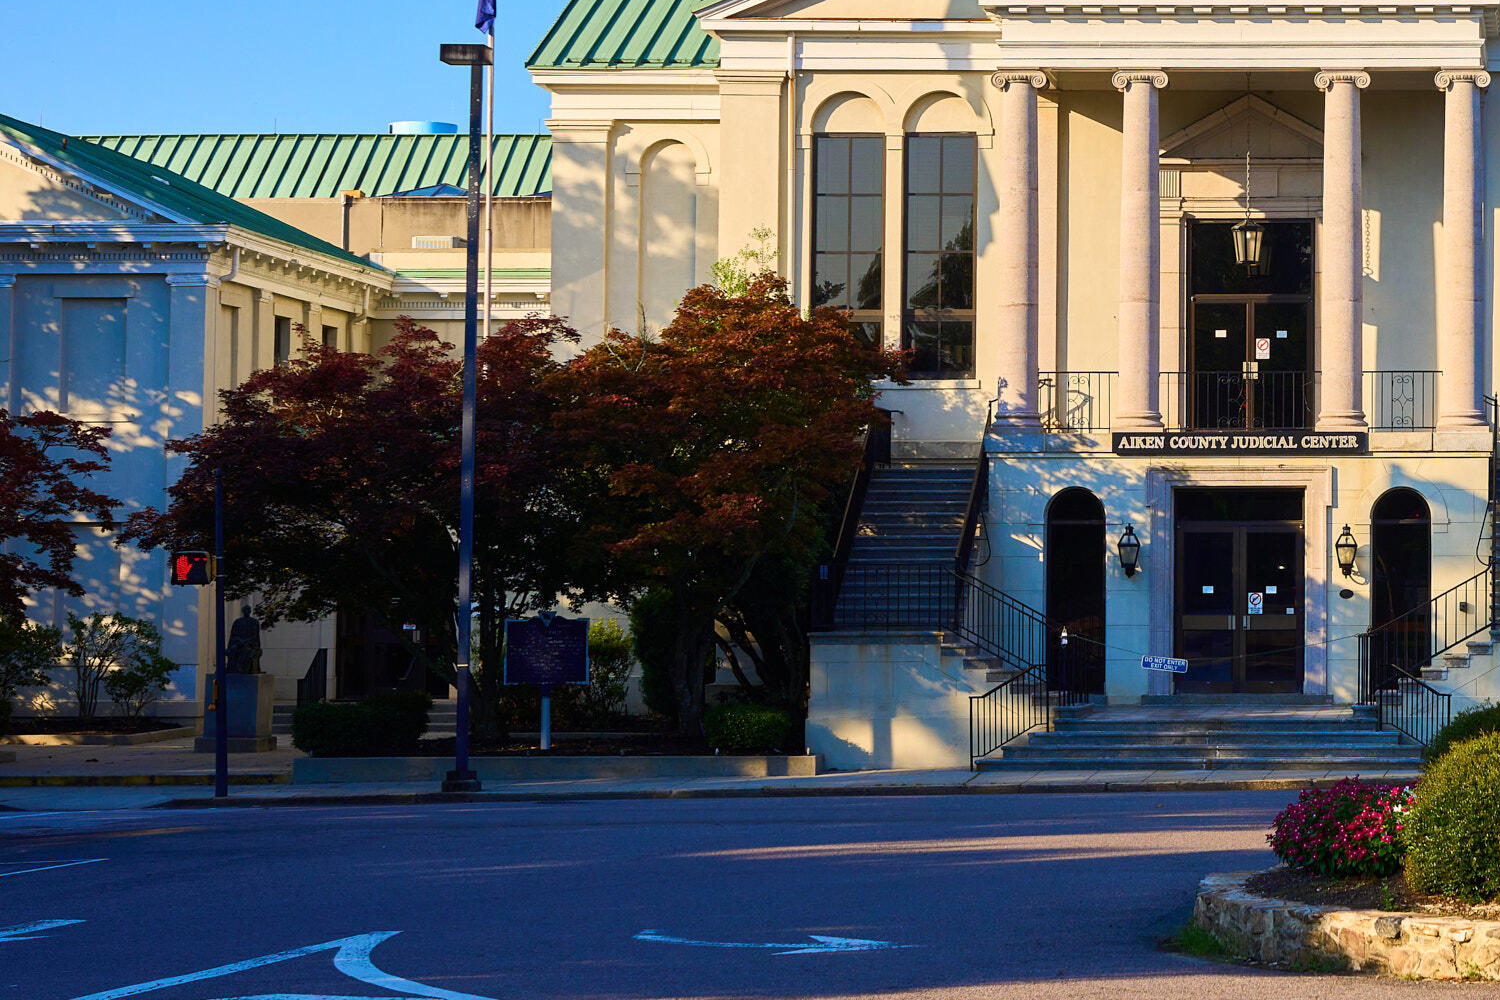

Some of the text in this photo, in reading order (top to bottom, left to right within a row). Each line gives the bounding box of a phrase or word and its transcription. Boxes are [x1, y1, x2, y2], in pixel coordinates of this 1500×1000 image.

[1118, 436, 1359, 449] AIKEN COUNTY JUDICIAL CENTER
